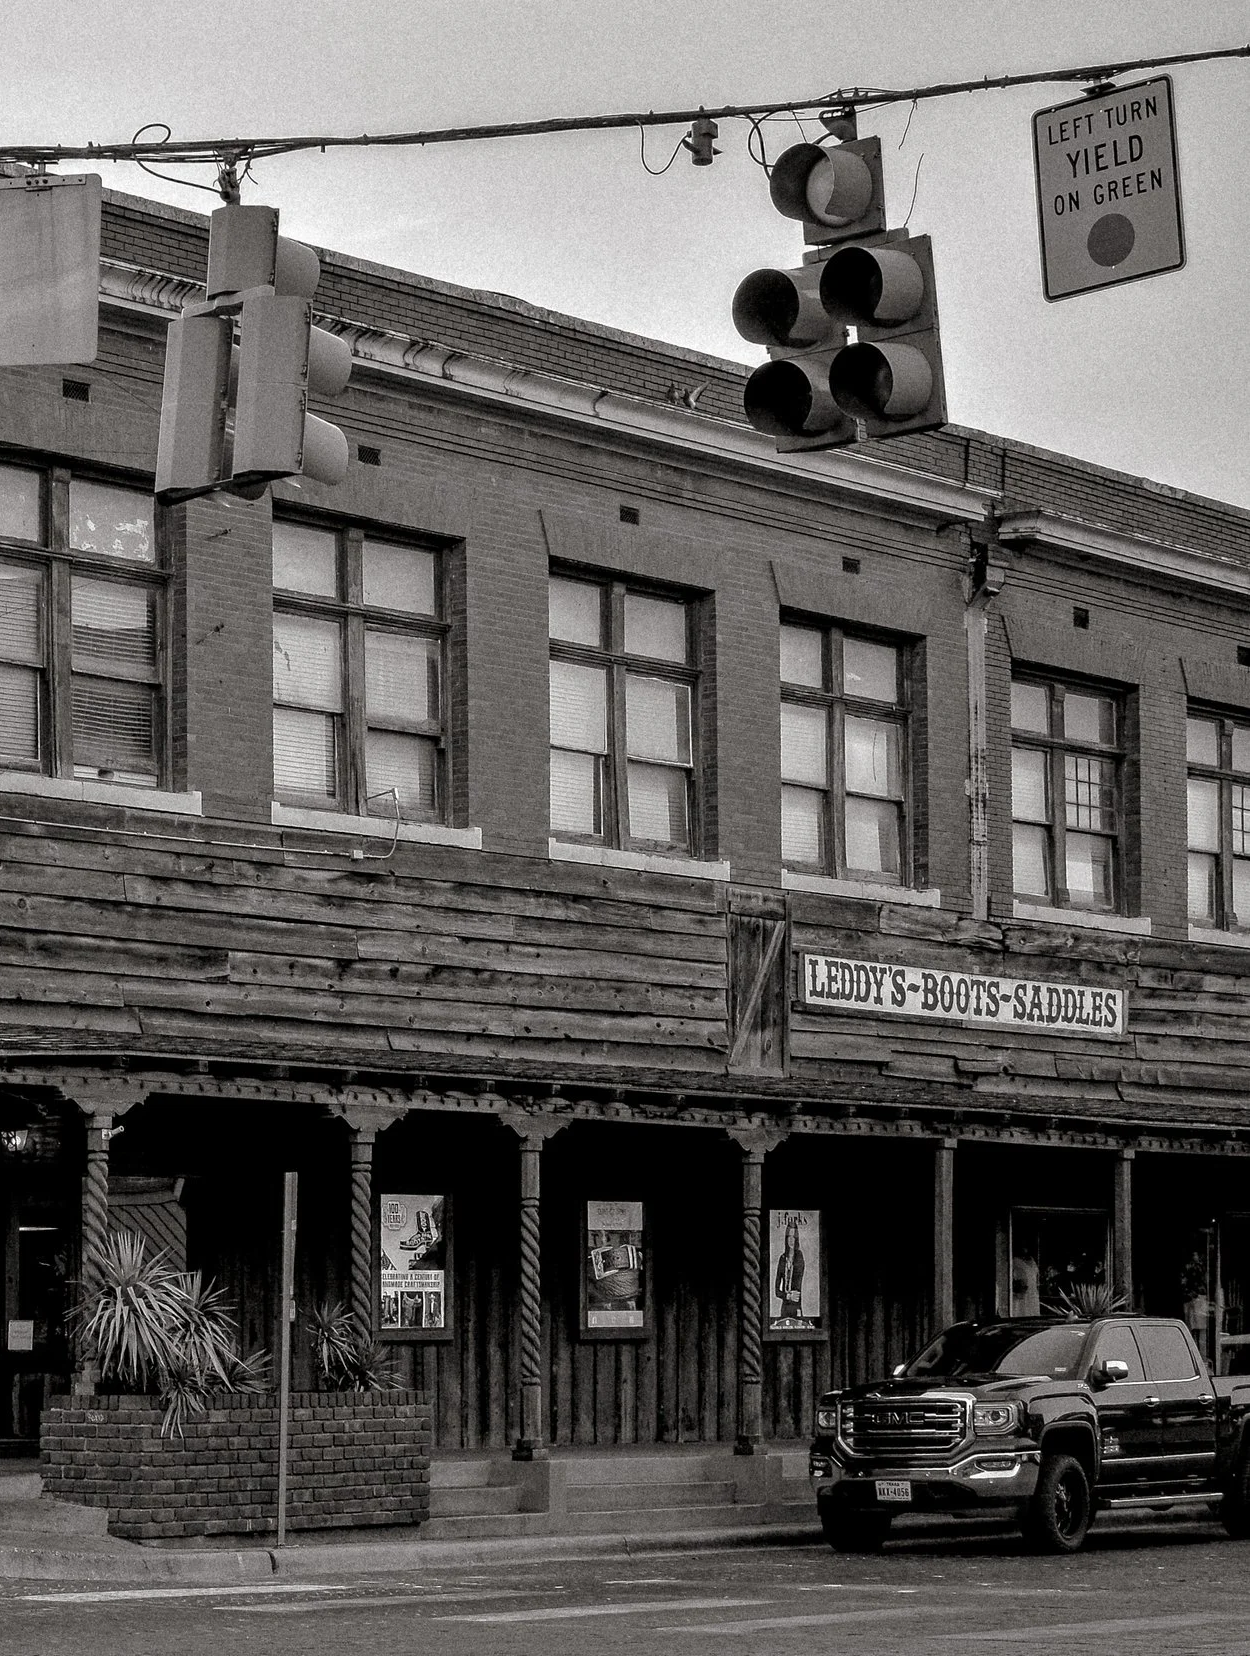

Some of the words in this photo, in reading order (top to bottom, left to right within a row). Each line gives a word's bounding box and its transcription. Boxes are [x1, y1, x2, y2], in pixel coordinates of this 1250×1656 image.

[1047, 113, 1094, 145] LEFT
[1103, 96, 1158, 129] TURN
[1065, 134, 1144, 179] YIELD
[1053, 190, 1080, 216] ON
[1093, 167, 1163, 205] GREEN
[808, 957, 907, 1008] LEDDY'S
[920, 971, 1001, 1018] BOOTS
[1013, 983, 1118, 1028] SADDLES
[381, 1280, 403, 1288] ANDMADE
[873, 1411, 925, 1425] GMC
